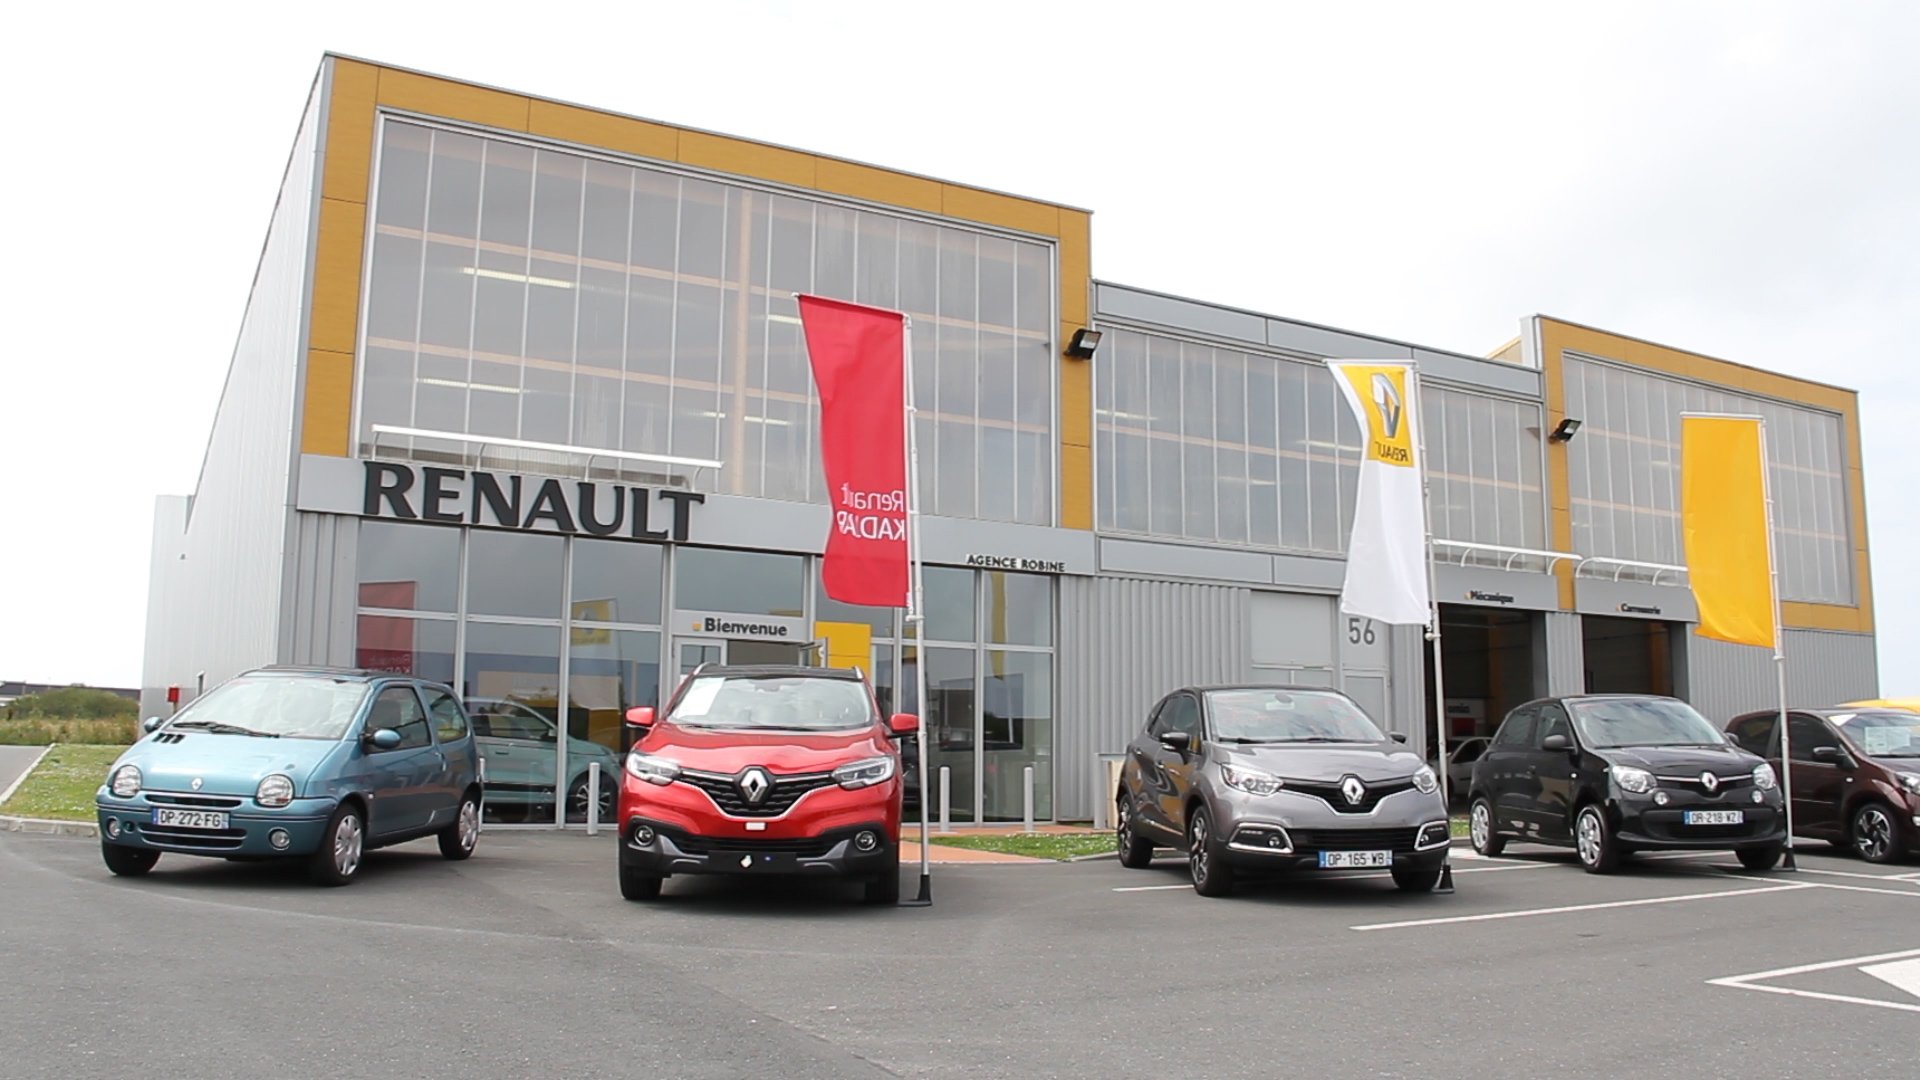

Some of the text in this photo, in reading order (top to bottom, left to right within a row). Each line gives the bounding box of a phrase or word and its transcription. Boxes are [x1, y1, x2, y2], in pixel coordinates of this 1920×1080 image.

[363, 461, 705, 541] RENAULT
[967, 554, 1065, 572] AGENCE ROBINE
[704, 618, 788, 636] Bienvenue
[1349, 618, 1376, 645] 56
